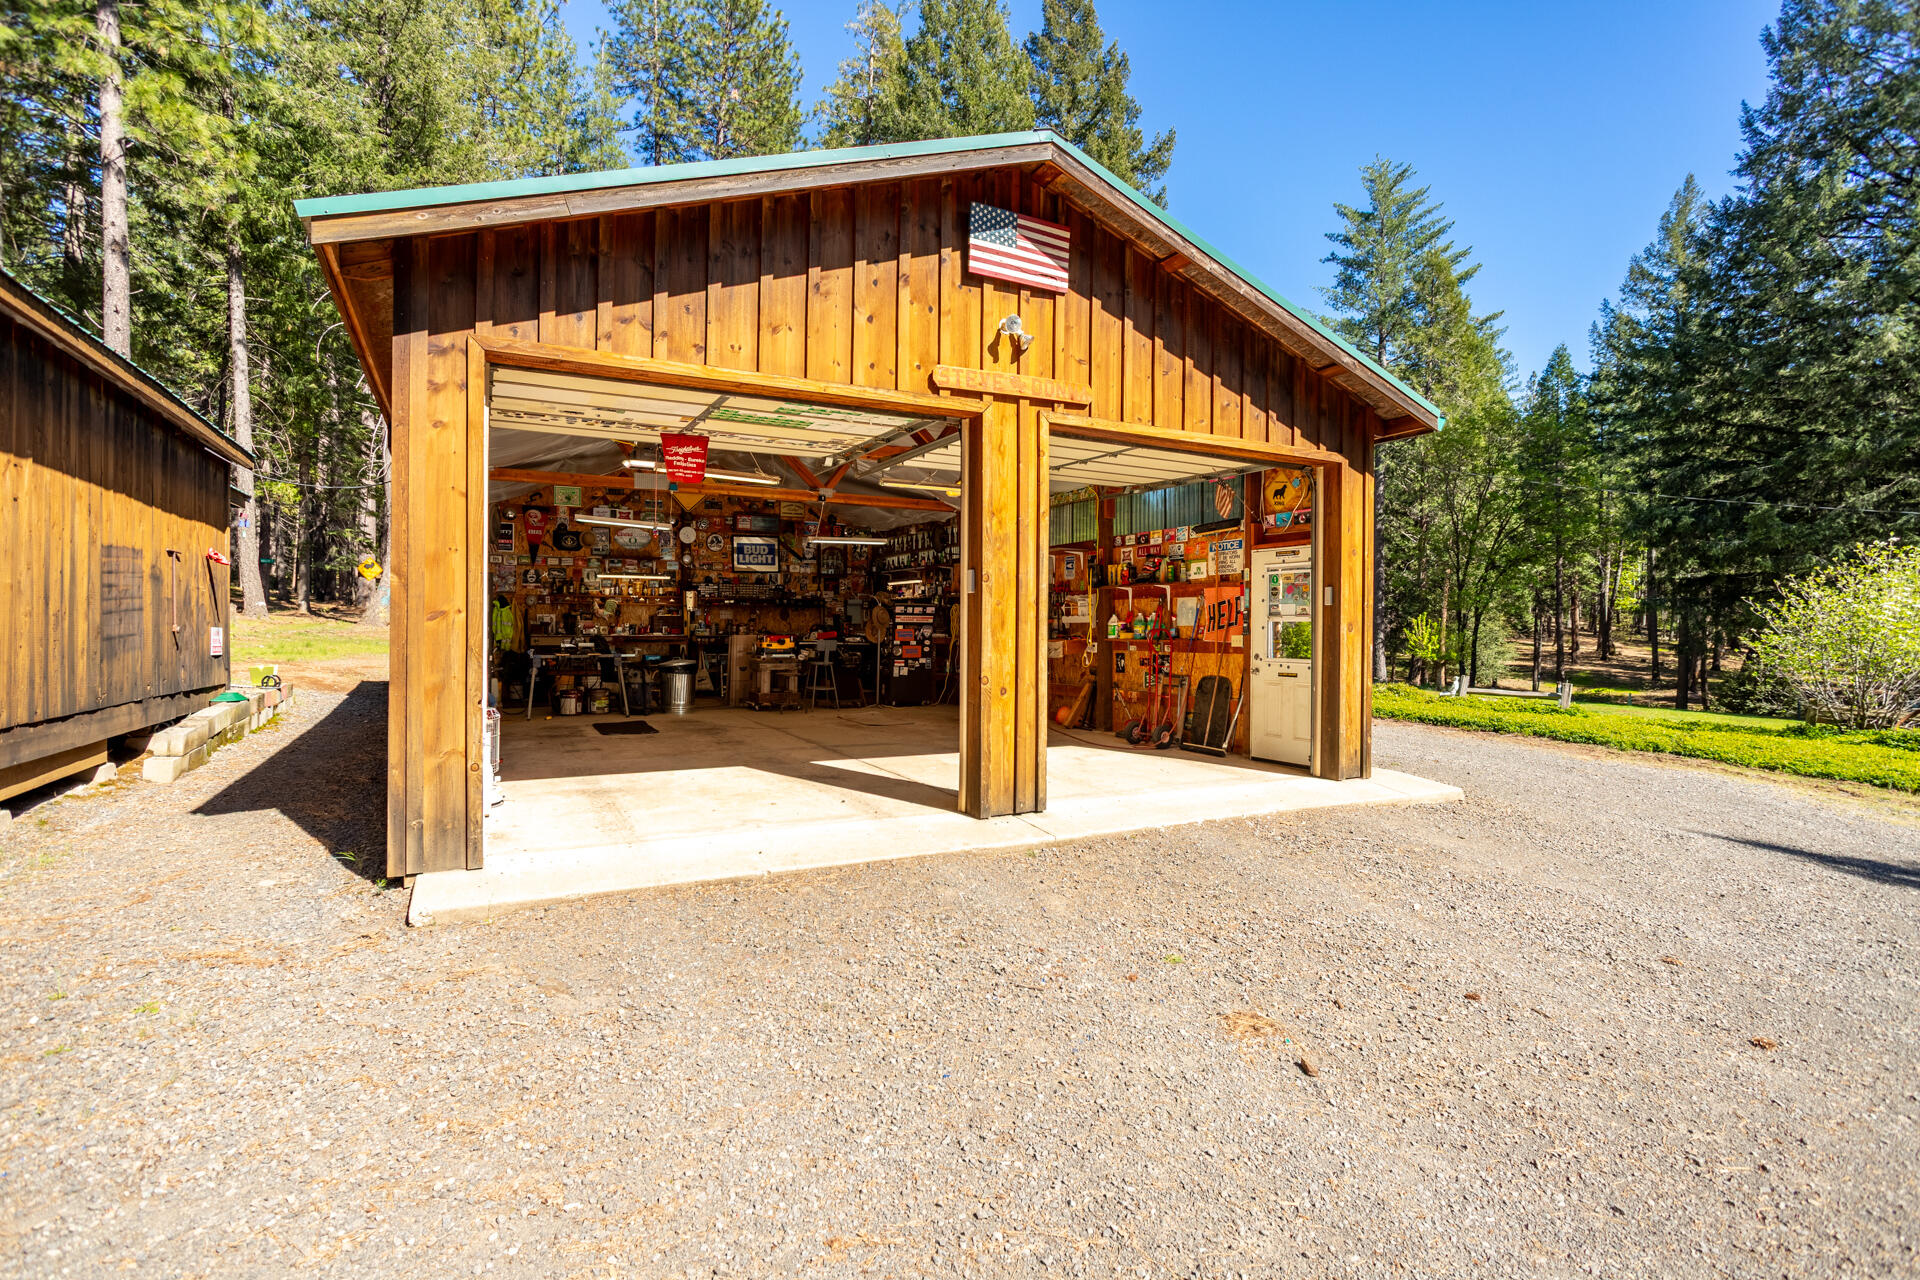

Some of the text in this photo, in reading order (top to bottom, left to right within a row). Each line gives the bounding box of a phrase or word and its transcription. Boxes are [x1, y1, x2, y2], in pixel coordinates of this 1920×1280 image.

[937, 366, 1003, 392] STEVE
[743, 545, 769, 555] BUD
[1138, 547, 1147, 556] ALL
[1150, 545, 1160, 554] WAY
[1212, 541, 1240, 551] NOTICE
[739, 554, 774, 564] LIGHT
